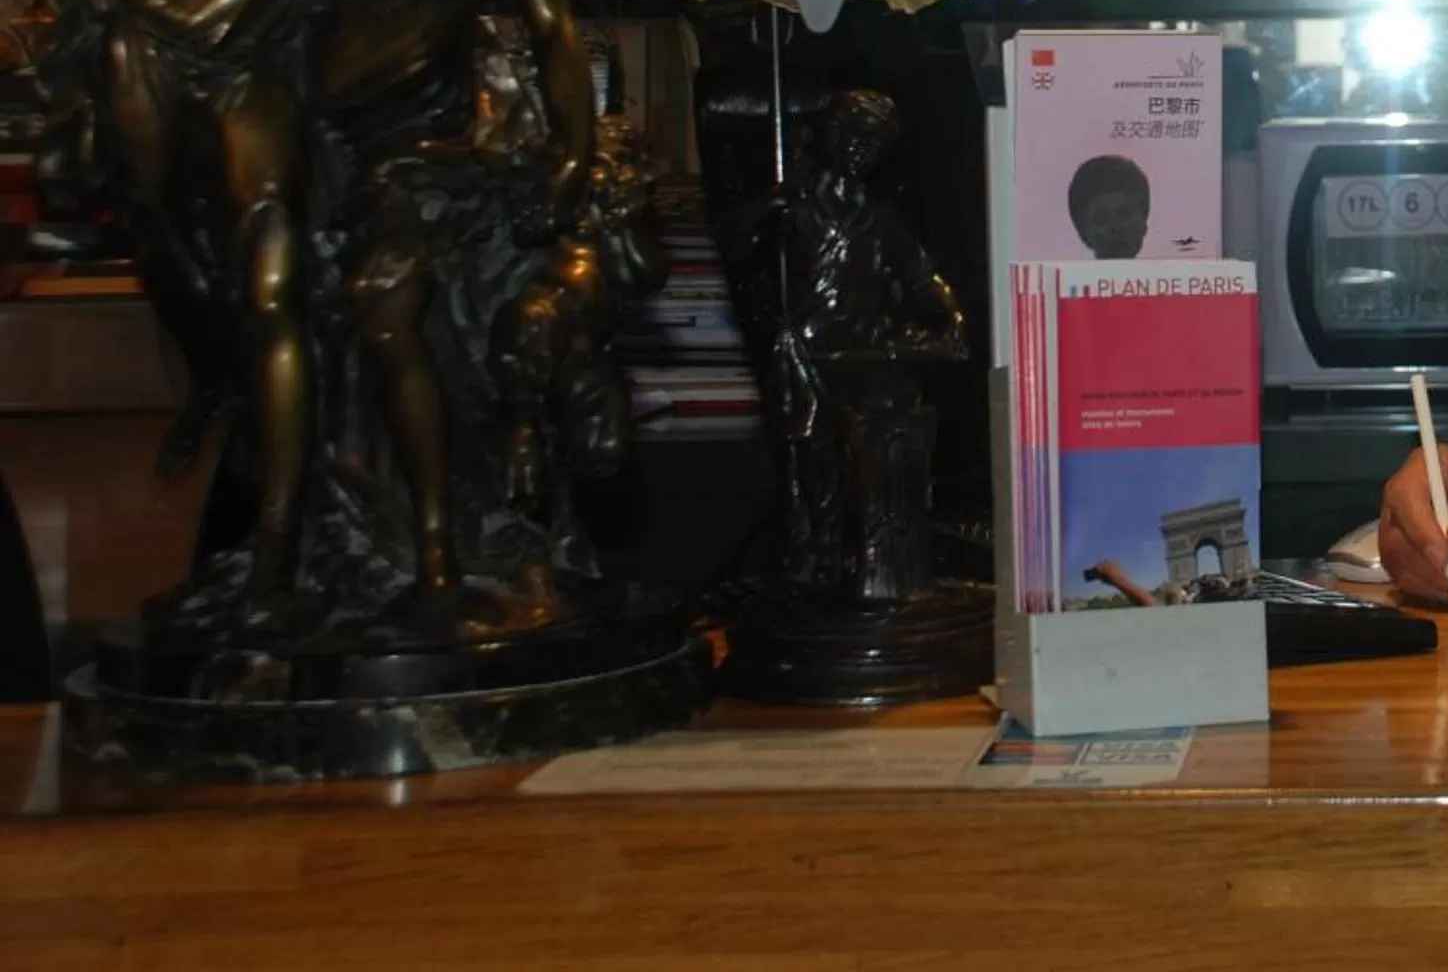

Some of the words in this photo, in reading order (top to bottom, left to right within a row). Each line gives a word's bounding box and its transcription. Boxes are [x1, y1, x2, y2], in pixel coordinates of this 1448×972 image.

[1148, 97, 1201, 115] 巴黎市
[1348, 196, 1379, 213] 17L
[1404, 191, 1419, 214] 6
[1098, 279, 1150, 296] PLAN
[1156, 278, 1182, 295] DE
[1188, 276, 1245, 295] PARIS
